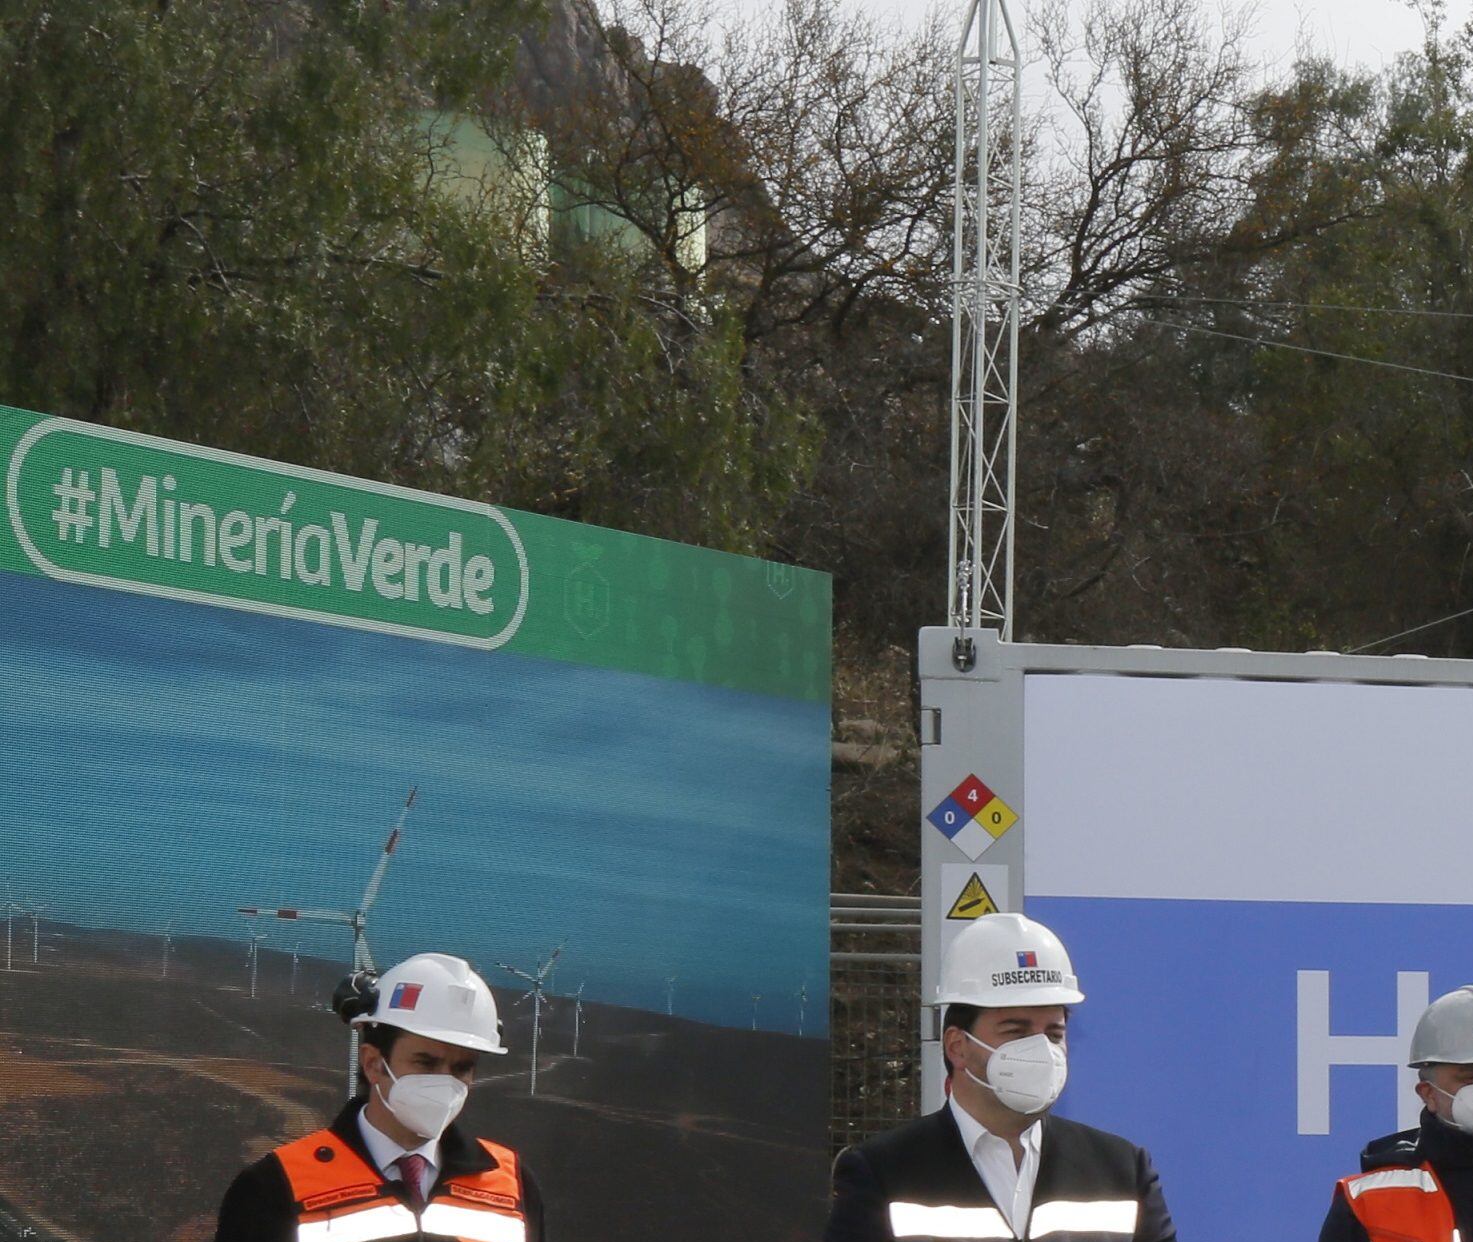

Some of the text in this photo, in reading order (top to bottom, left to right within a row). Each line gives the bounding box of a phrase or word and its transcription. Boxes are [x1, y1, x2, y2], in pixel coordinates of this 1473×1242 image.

[52, 466, 494, 615] #MineríaVerde
[967, 788, 978, 802] 4
[944, 811, 955, 824] 0
[991, 811, 1002, 824] 0
[992, 970, 1062, 987] SUBSECRETARIO
